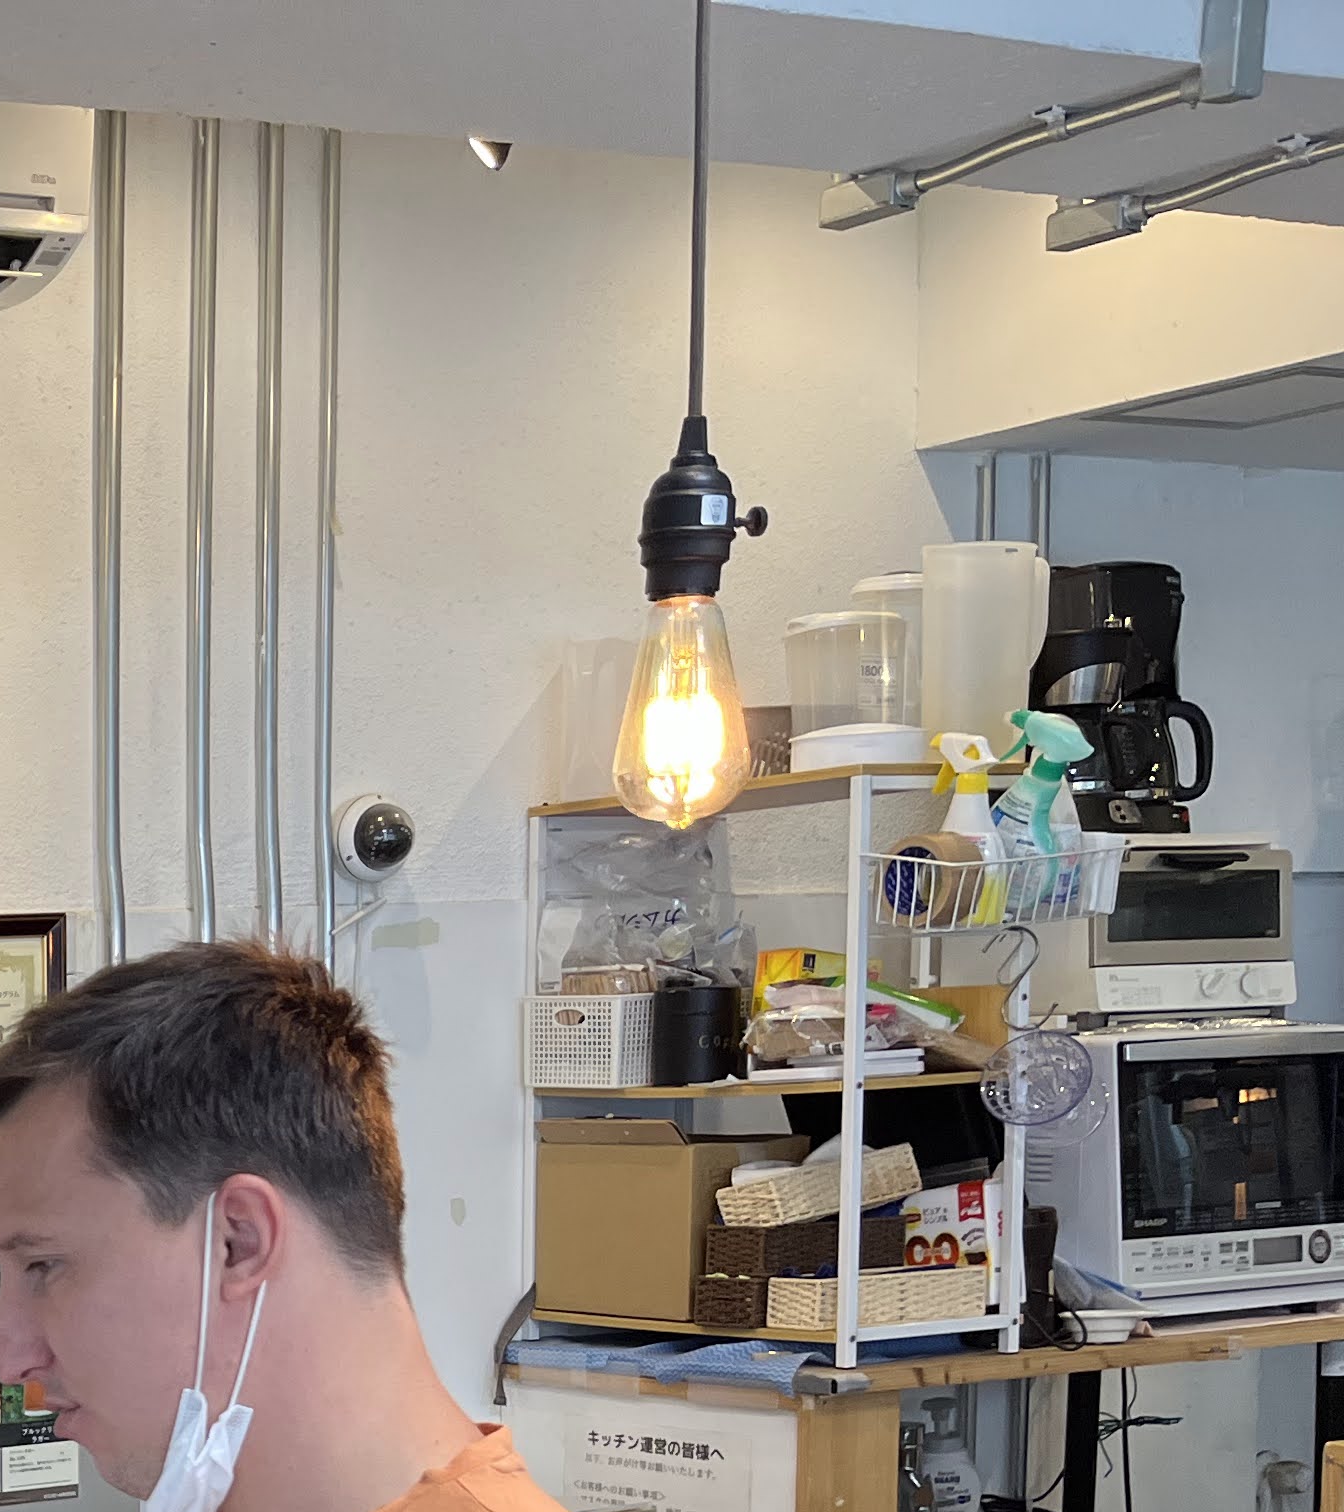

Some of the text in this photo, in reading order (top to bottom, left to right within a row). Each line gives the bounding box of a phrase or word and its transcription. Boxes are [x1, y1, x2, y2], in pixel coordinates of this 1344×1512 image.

[587, 1429, 725, 1461] キッチン運営の皆様へ
